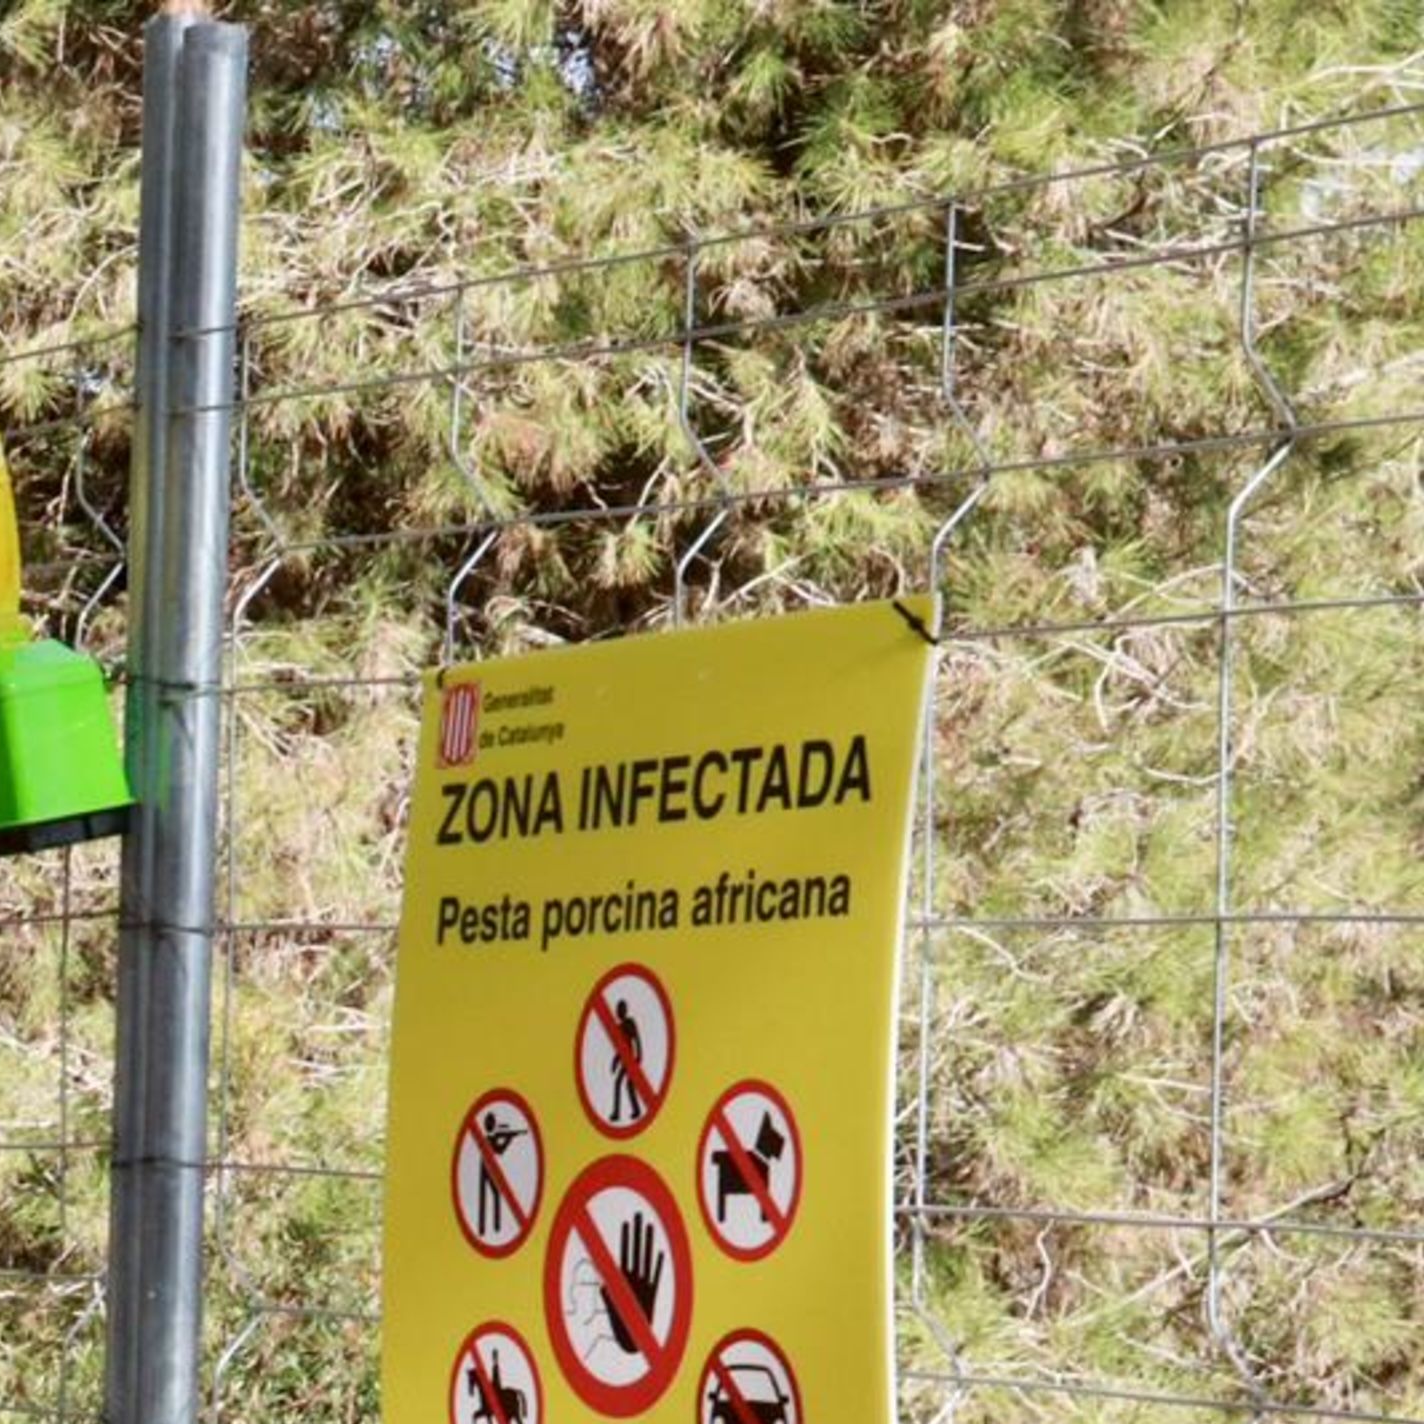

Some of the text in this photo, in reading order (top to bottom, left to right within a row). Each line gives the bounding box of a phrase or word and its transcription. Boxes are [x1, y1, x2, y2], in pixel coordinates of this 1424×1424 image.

[483, 686, 554, 713] Generalitat
[479, 722, 564, 749] de Catalunya
[437, 735, 871, 845] ZONA INFECTADA
[437, 868, 850, 952] Pesta porcina africana
